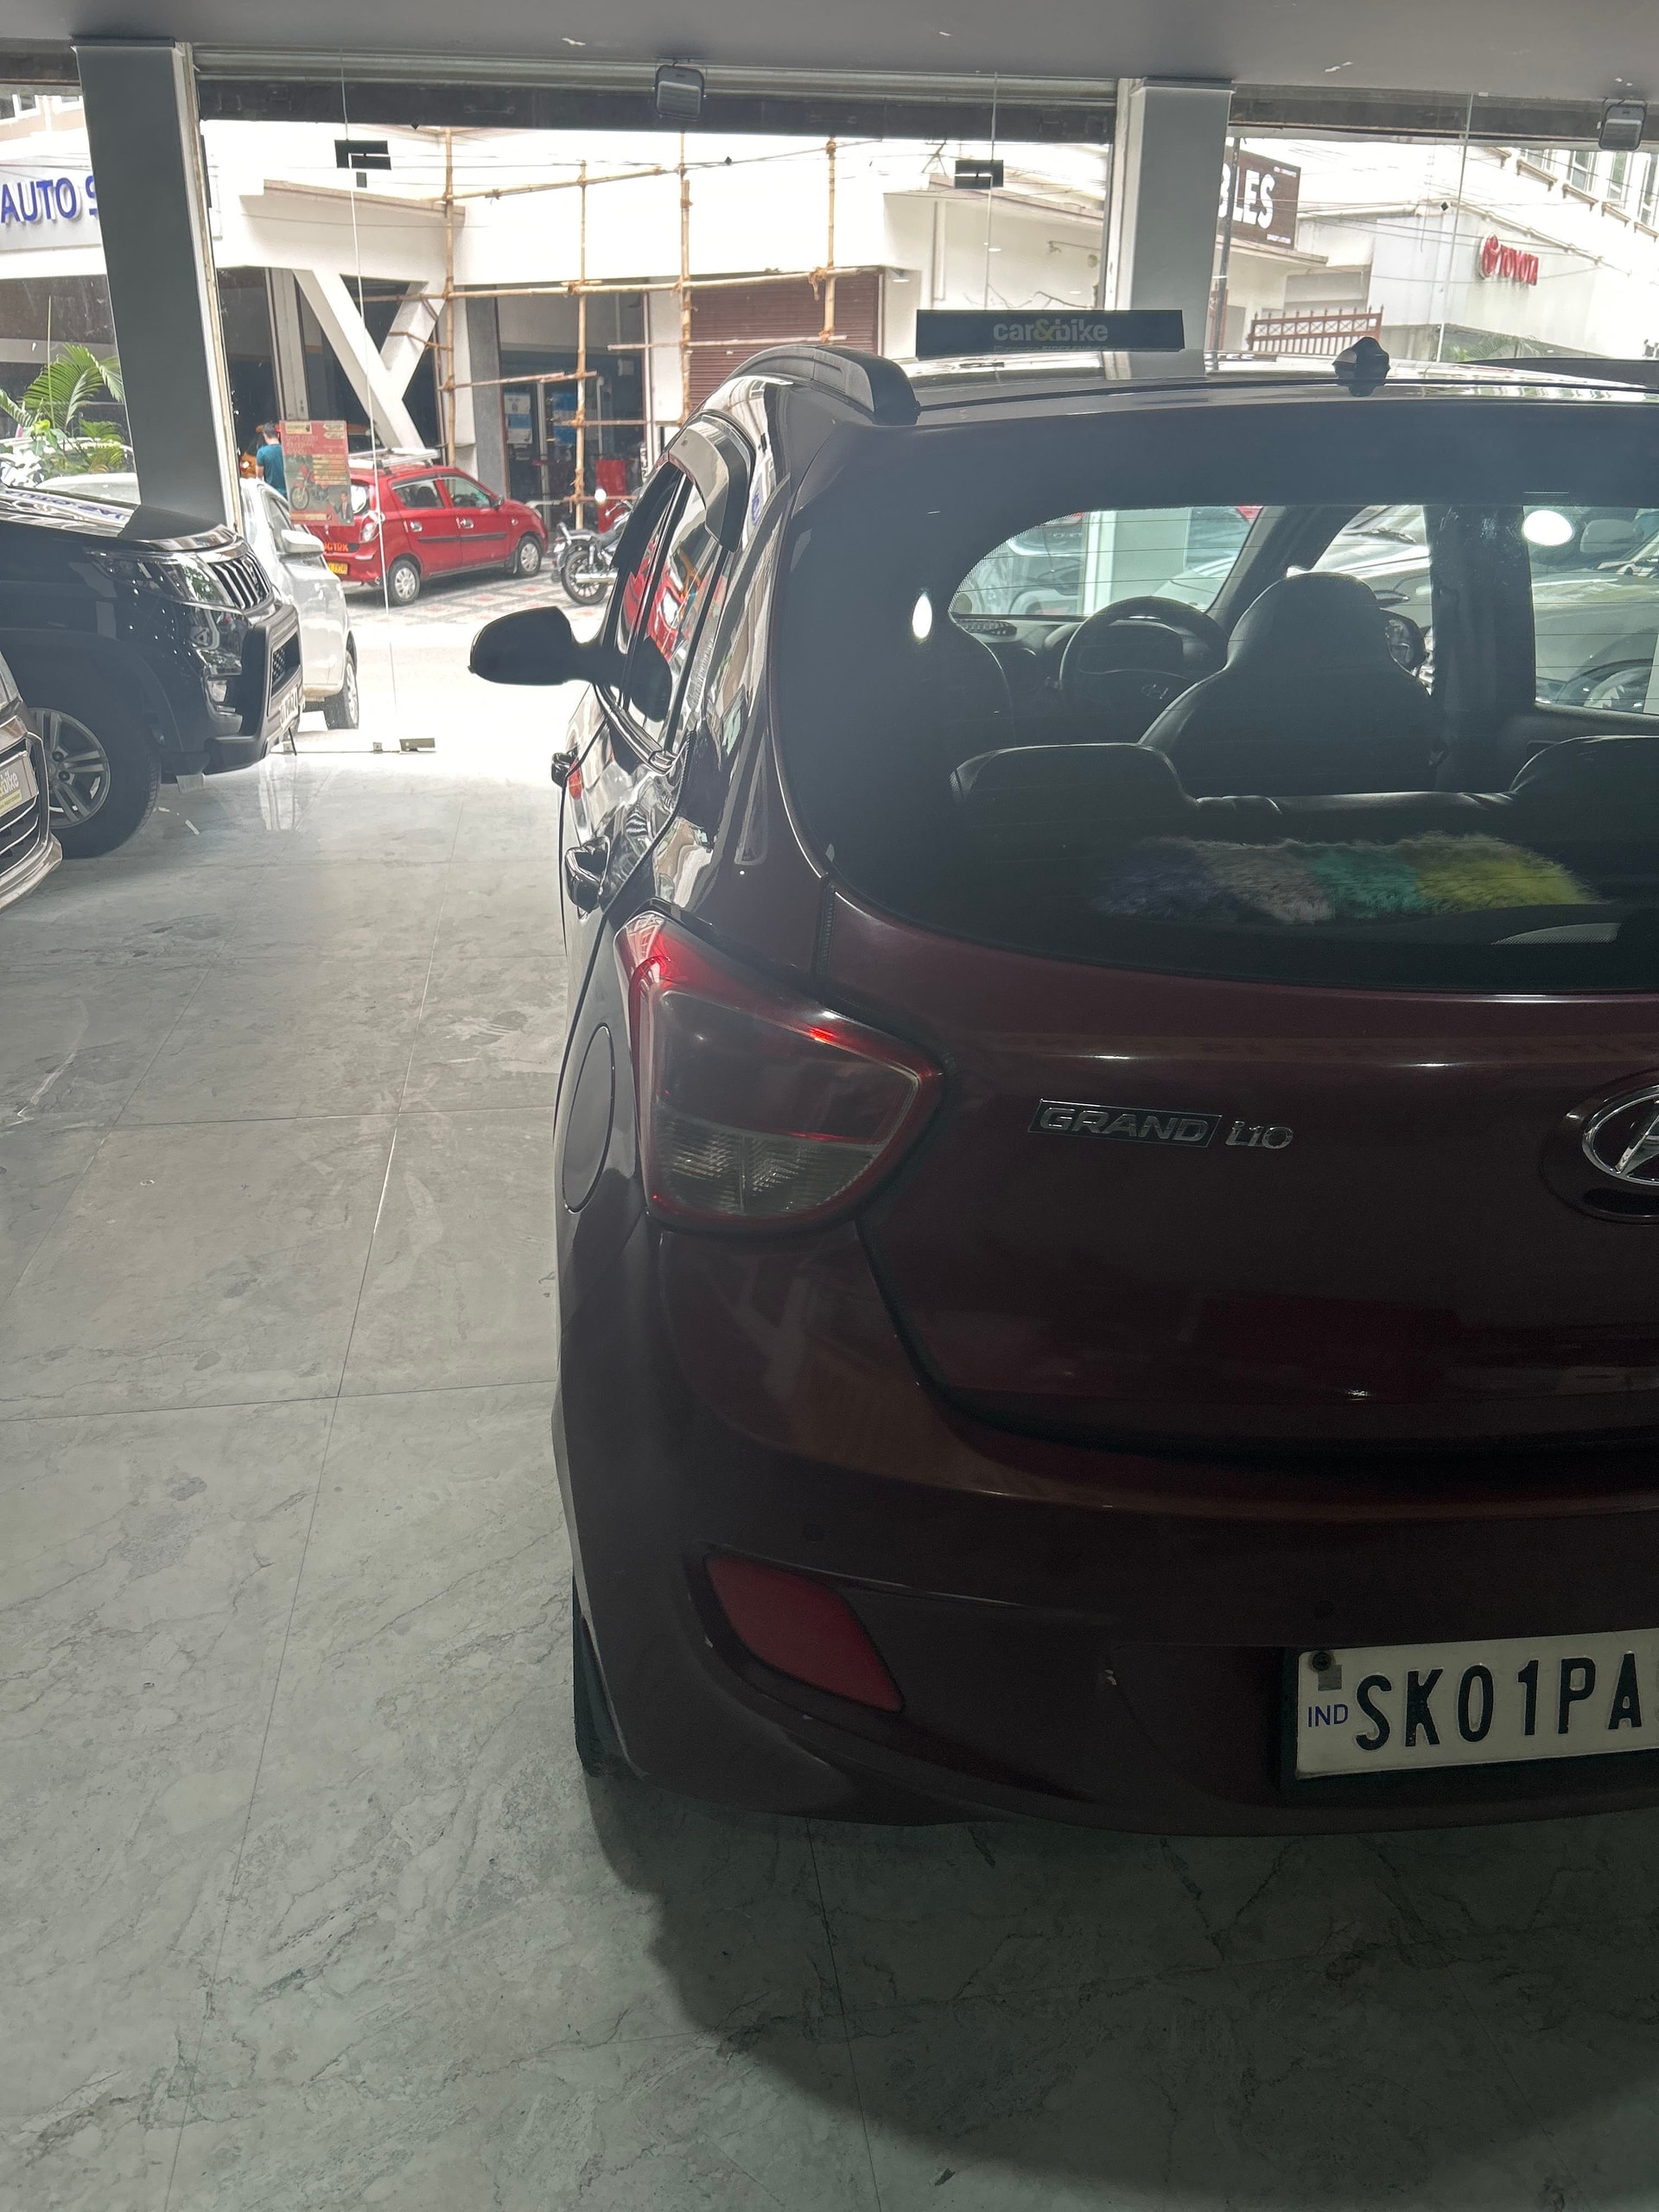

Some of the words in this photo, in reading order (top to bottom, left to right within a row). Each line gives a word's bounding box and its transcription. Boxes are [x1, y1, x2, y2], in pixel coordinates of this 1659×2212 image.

[1, 177, 77, 223] AUTO
[1499, 244, 1539, 286] TOYOTA
[994, 318, 1109, 342] car&bike
[1039, 1106, 1208, 1142] GRAND
[1307, 1703, 1349, 1727] IND
[1355, 1651, 1643, 1751] SK01PA
